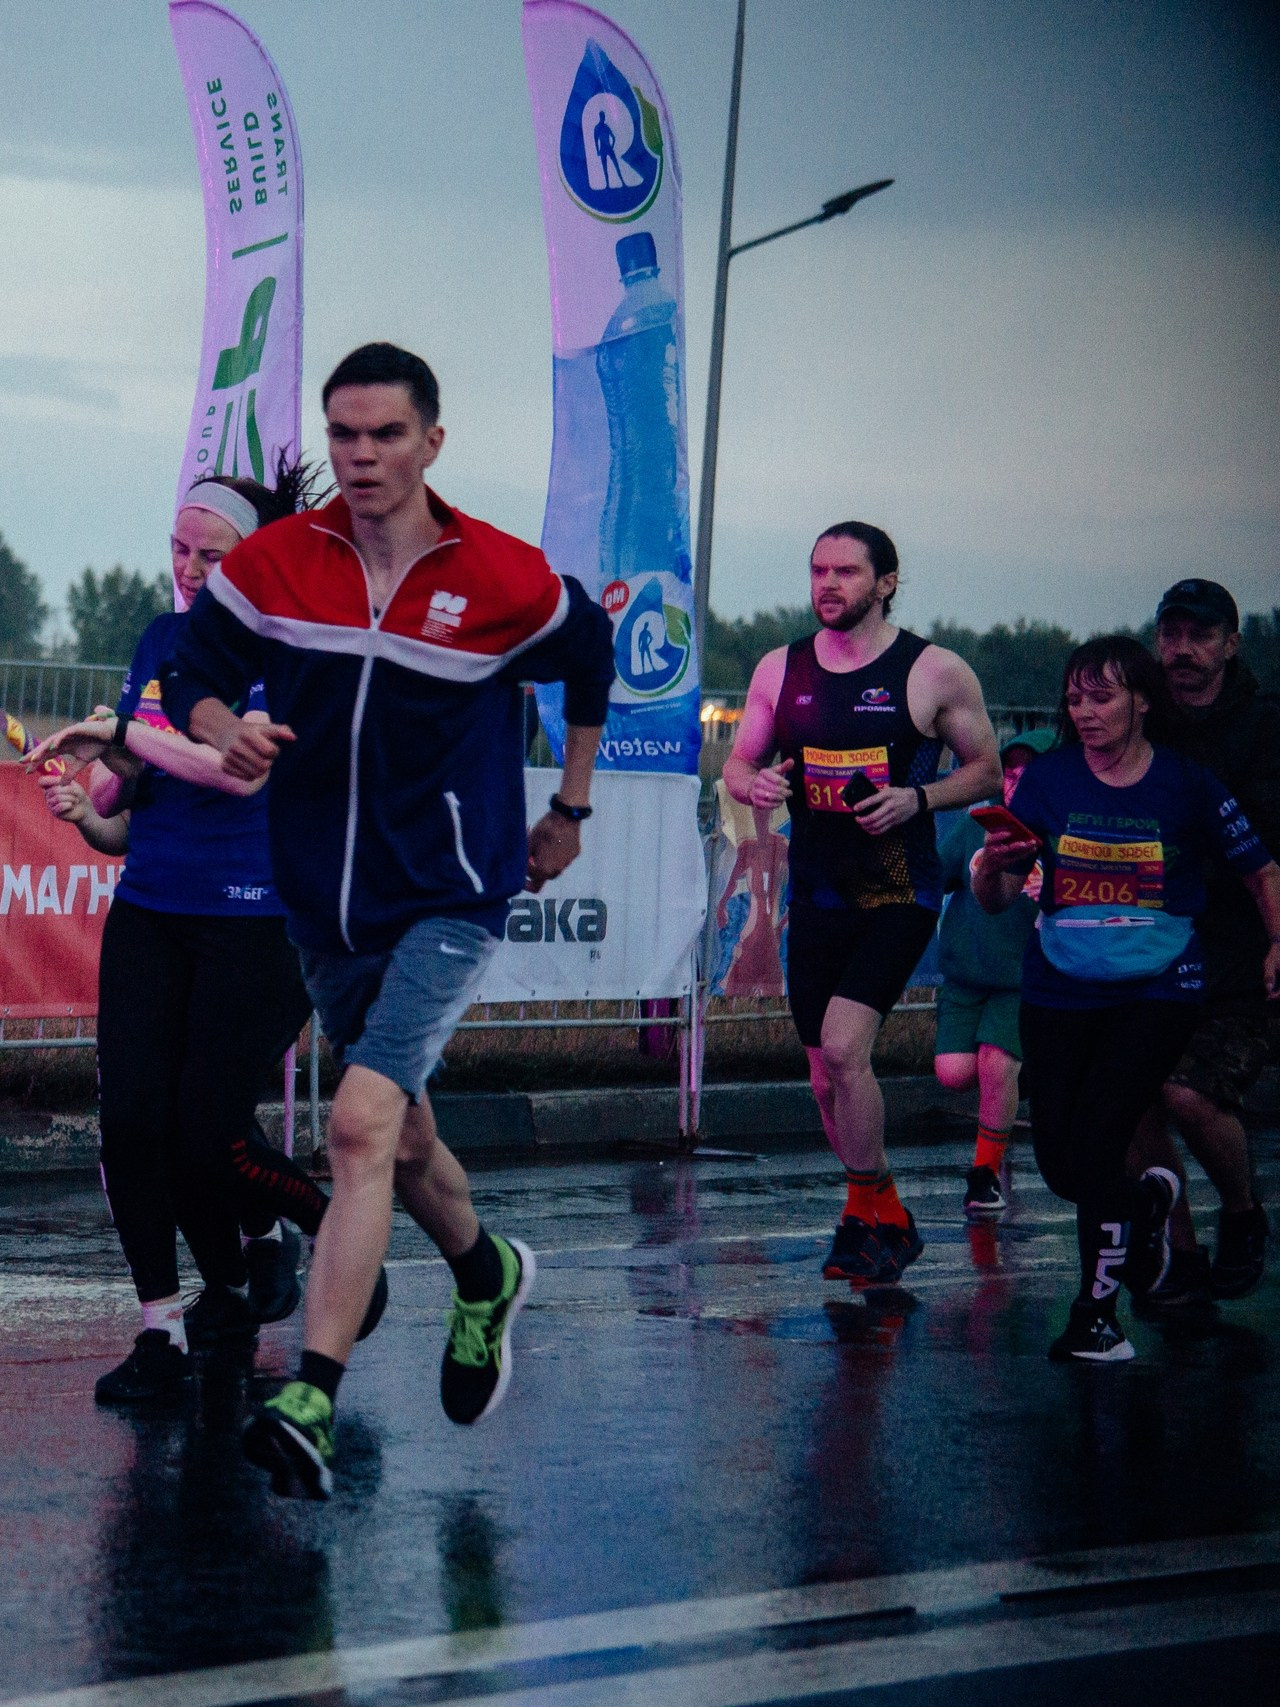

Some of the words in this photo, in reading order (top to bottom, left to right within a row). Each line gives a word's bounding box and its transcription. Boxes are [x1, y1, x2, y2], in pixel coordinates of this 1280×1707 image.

[853, 705, 897, 713] ПРОМИС
[809, 783, 848, 808] 31
[0, 864, 126, 915] МАГН
[1061, 877, 1134, 903] 2406
[1092, 1220, 1129, 1299] FILA
